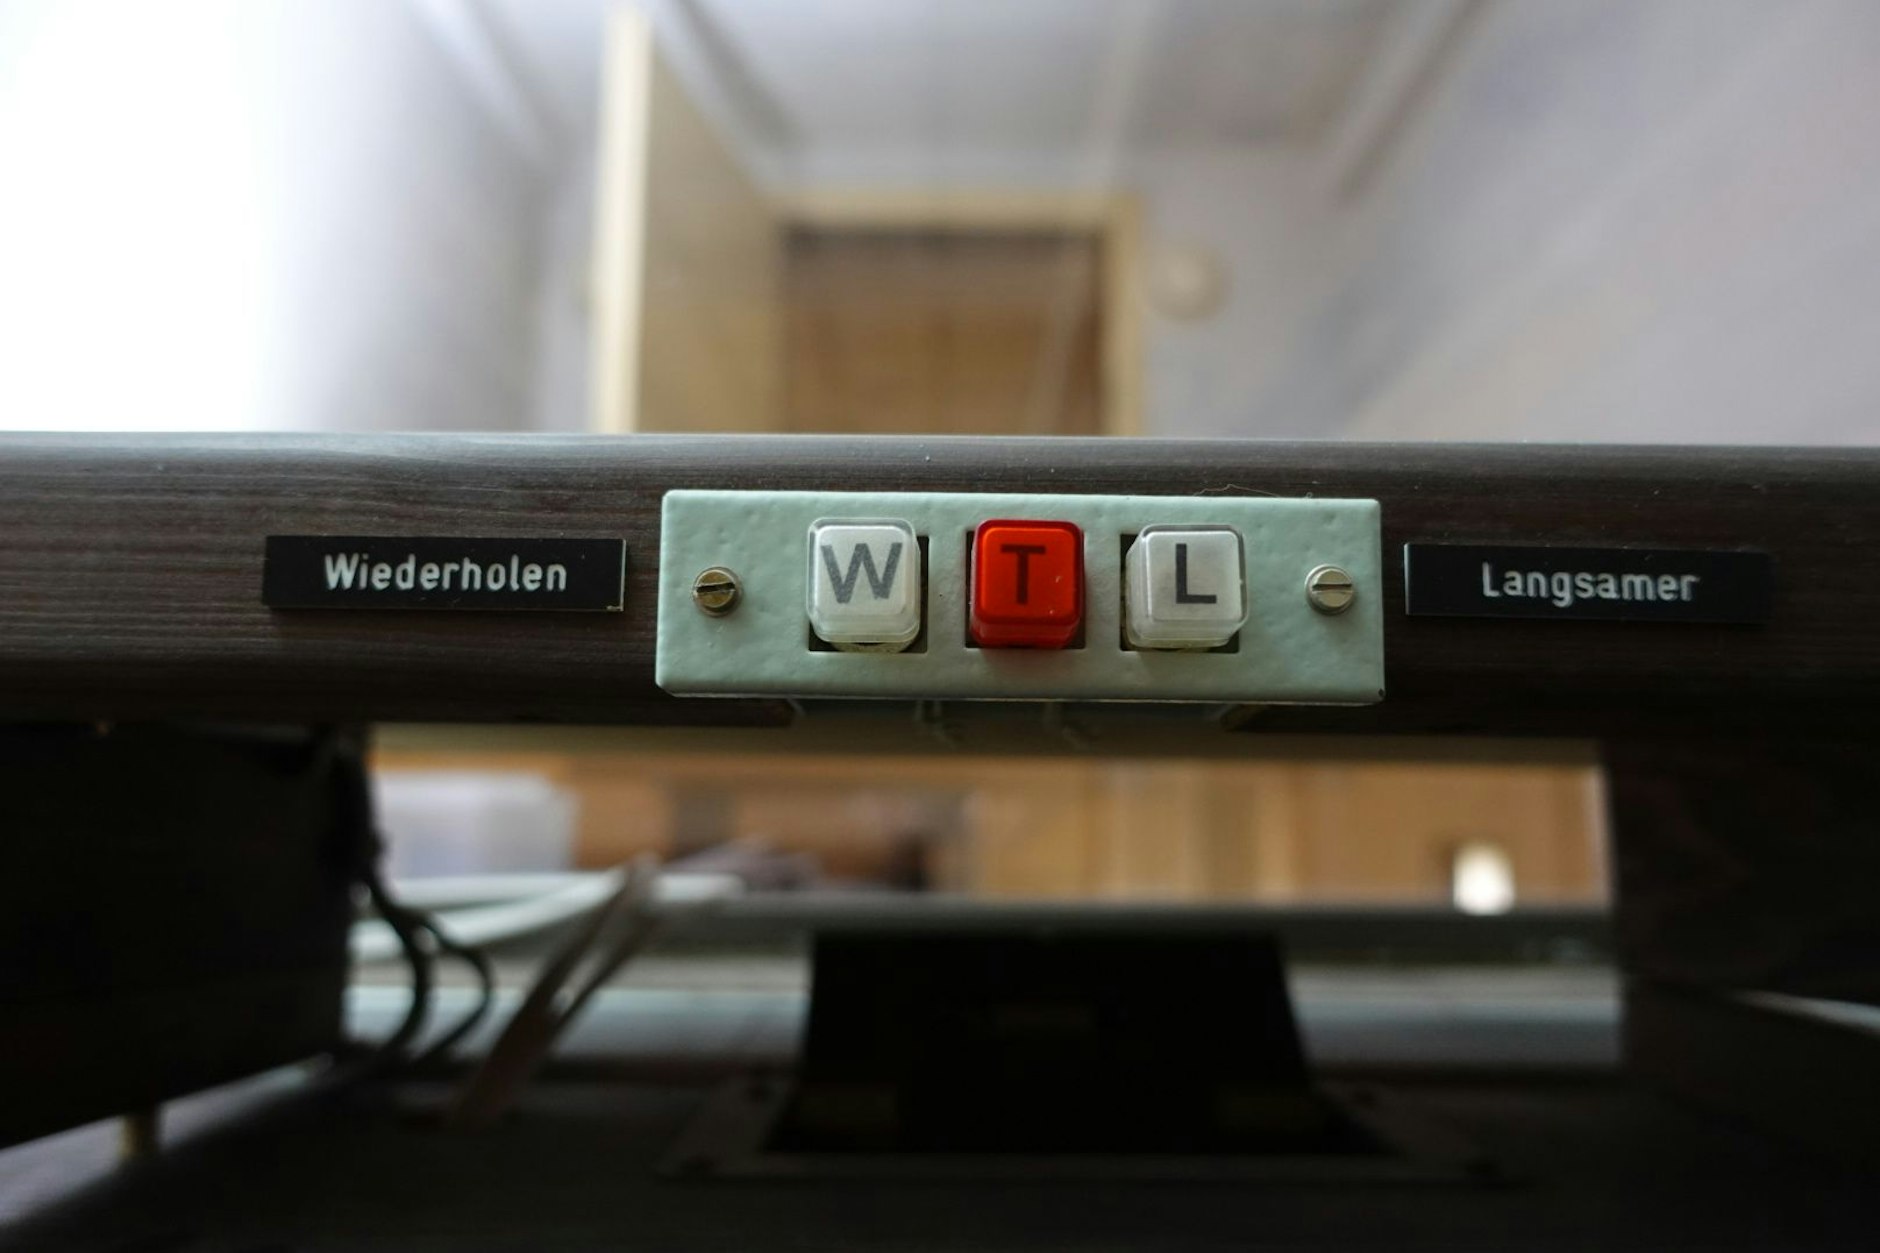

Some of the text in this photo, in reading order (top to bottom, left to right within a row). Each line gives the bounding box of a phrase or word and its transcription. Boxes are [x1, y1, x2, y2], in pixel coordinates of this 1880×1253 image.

[324, 552, 568, 592] Wiederholen
[820, 541, 903, 605] W
[1000, 543, 1047, 606] T
[1174, 542, 1218, 605] L
[1481, 561, 1701, 608] Langsamer
